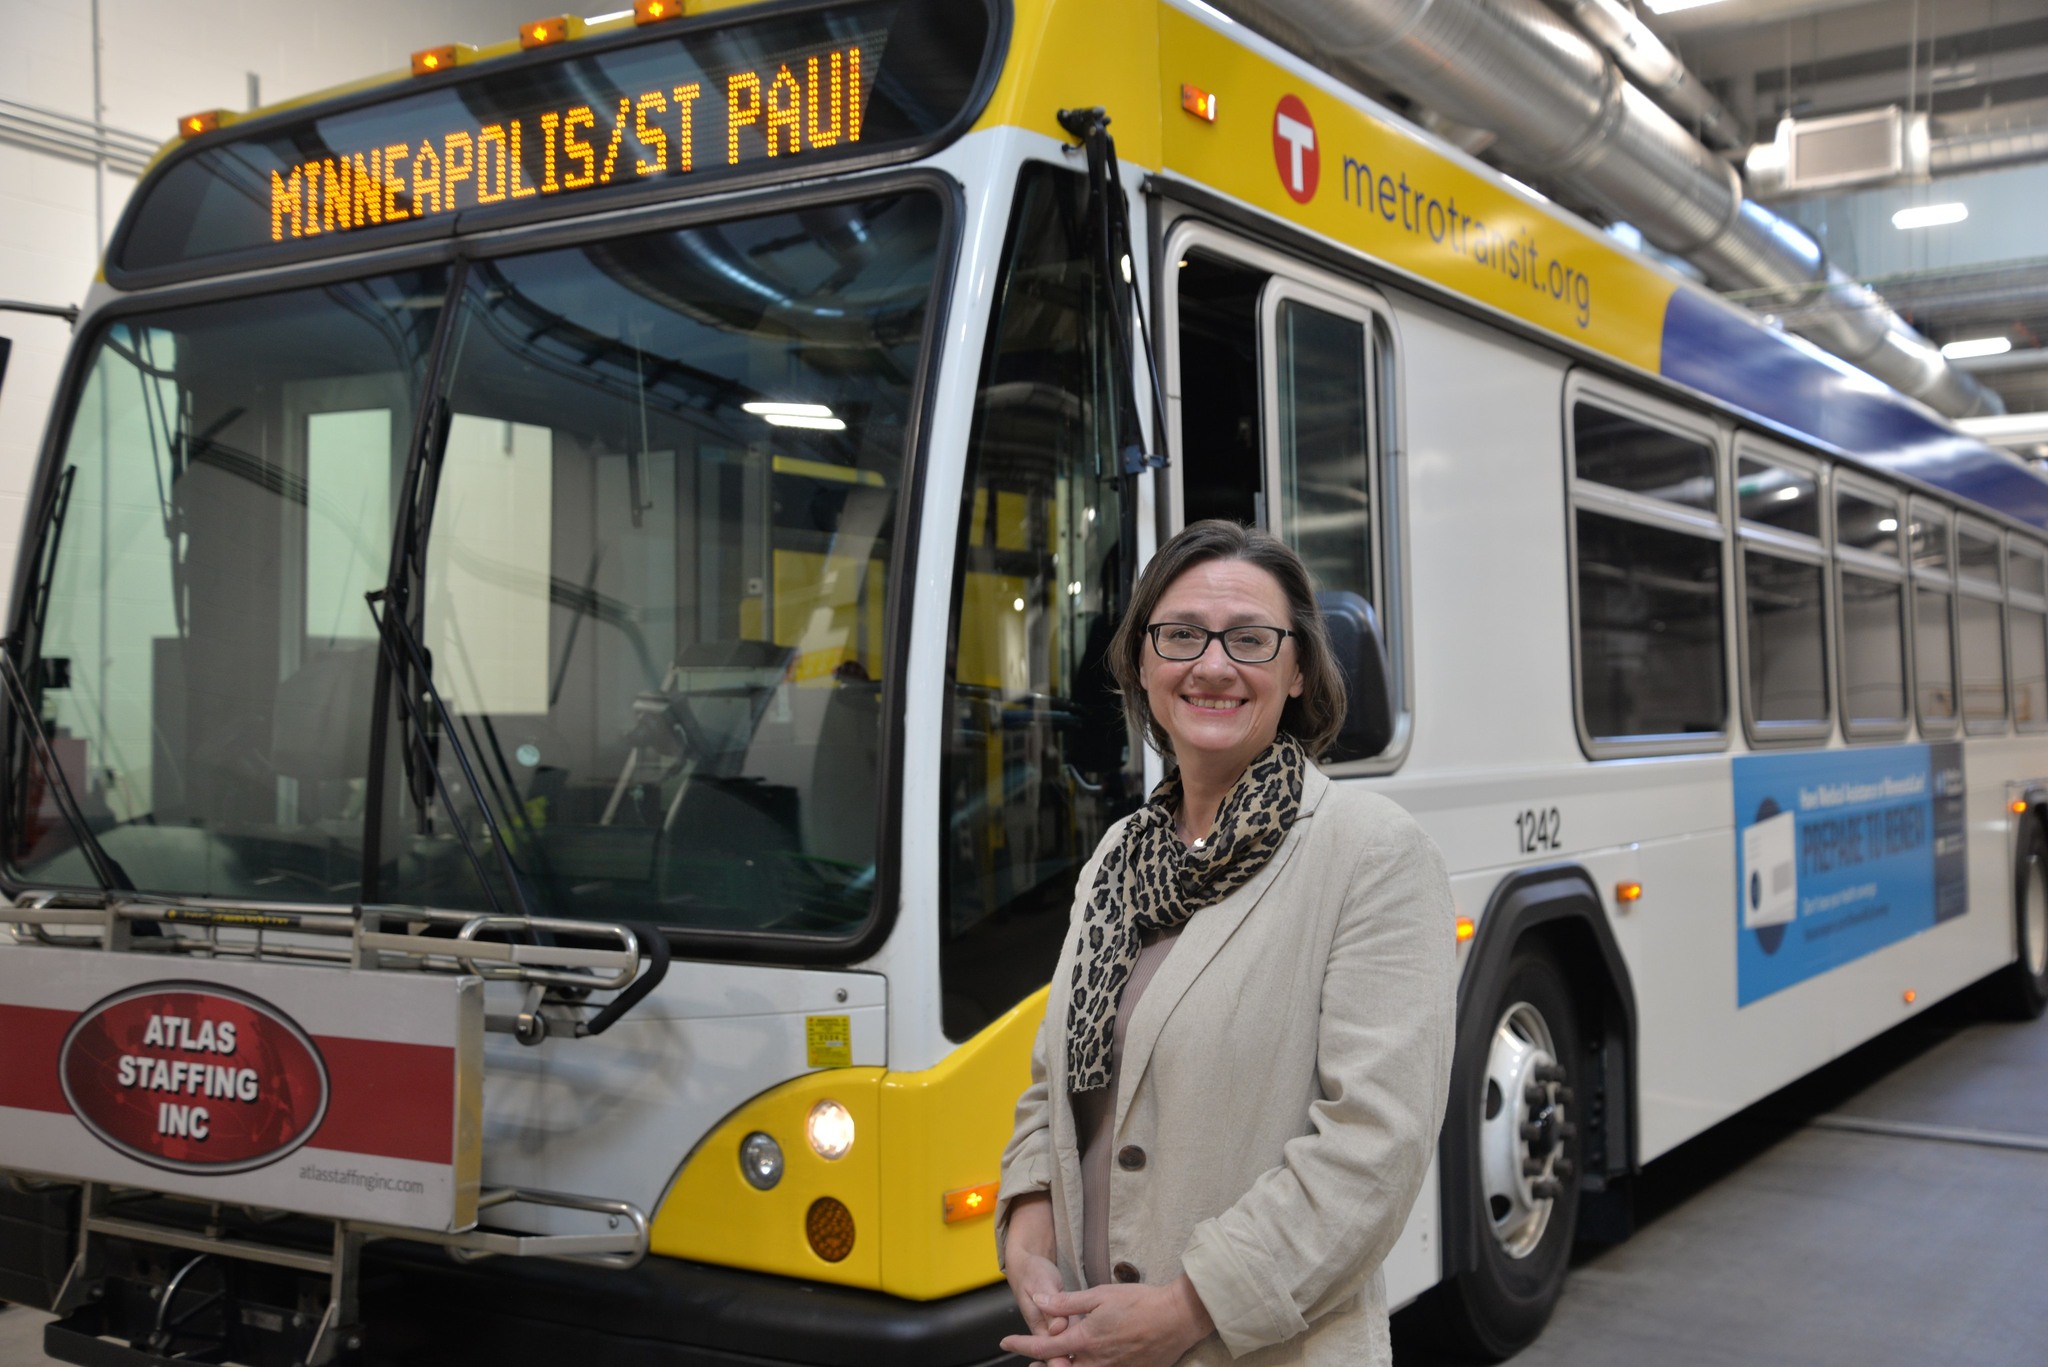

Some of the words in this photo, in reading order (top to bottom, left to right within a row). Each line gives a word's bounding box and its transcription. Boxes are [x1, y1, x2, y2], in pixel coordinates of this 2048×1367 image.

[271, 83, 700, 241] MINNEAPOLIS/ST
[1343, 154, 1590, 330] metrotransit.org
[1515, 807, 1561, 853] 1242
[143, 1014, 237, 1055] ATLAS
[117, 1054, 259, 1102] STAFFING
[158, 1102, 210, 1140] INC
[299, 1164, 424, 1193] atlasstaffinginc.com
